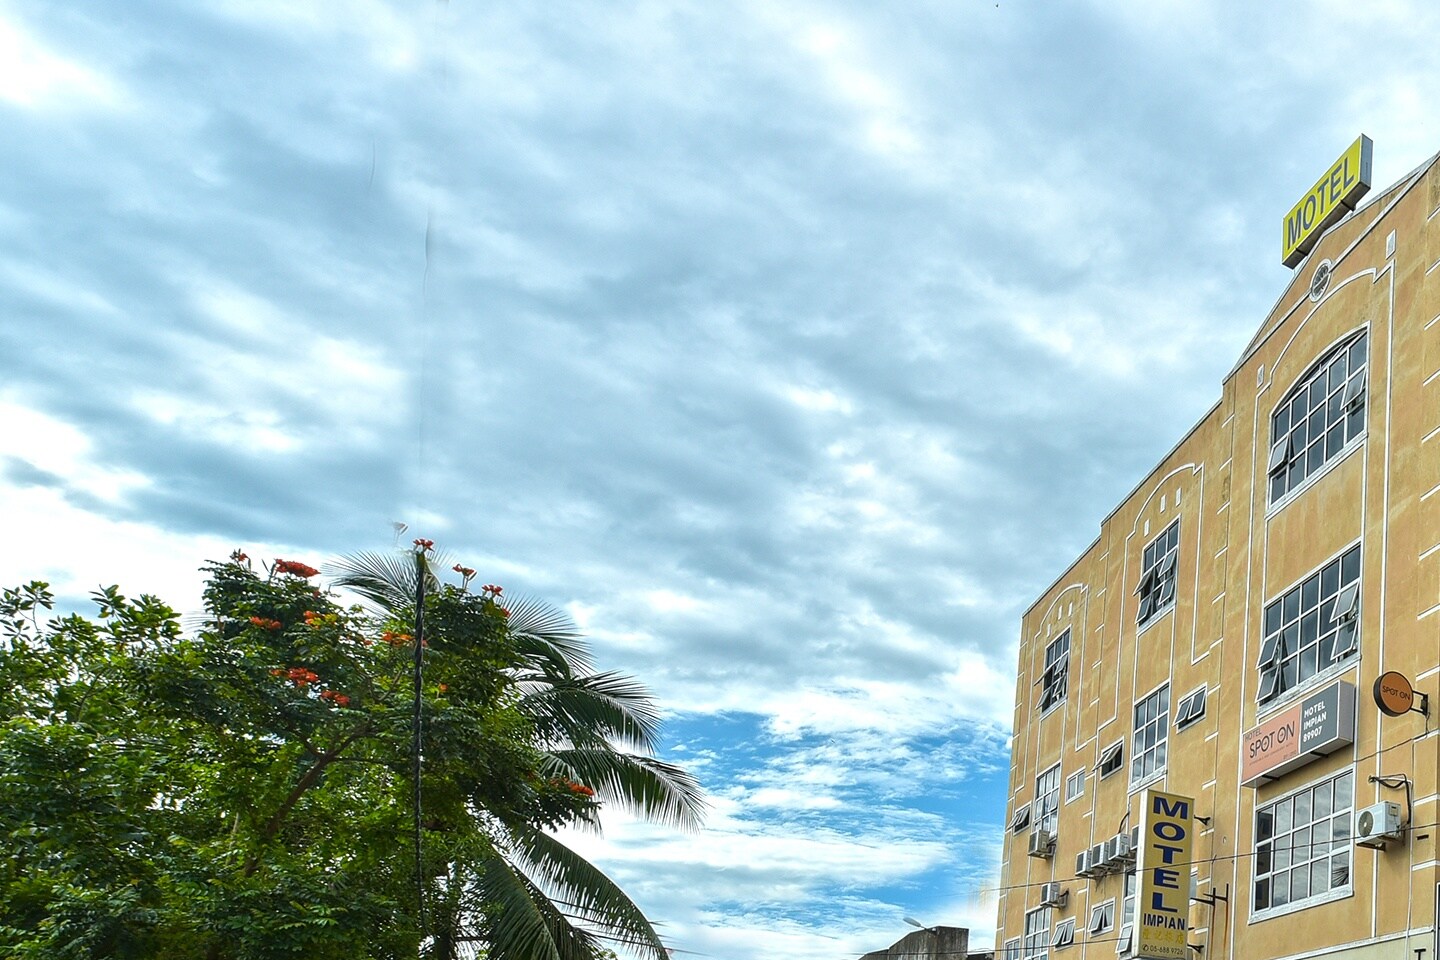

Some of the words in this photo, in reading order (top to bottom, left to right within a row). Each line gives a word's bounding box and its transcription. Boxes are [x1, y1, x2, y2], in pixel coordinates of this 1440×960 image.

[1287, 156, 1355, 250] MOTEL
[1383, 685, 1398, 696] SPOT
[1399, 691, 1410, 700] ON
[1304, 711, 1326, 730] IMPIAN
[1250, 731, 1276, 758] SPOT
[1277, 721, 1295, 743] ON
[1152, 796, 1189, 913] MOTEL
[1143, 913, 1185, 930] IMPIAN
